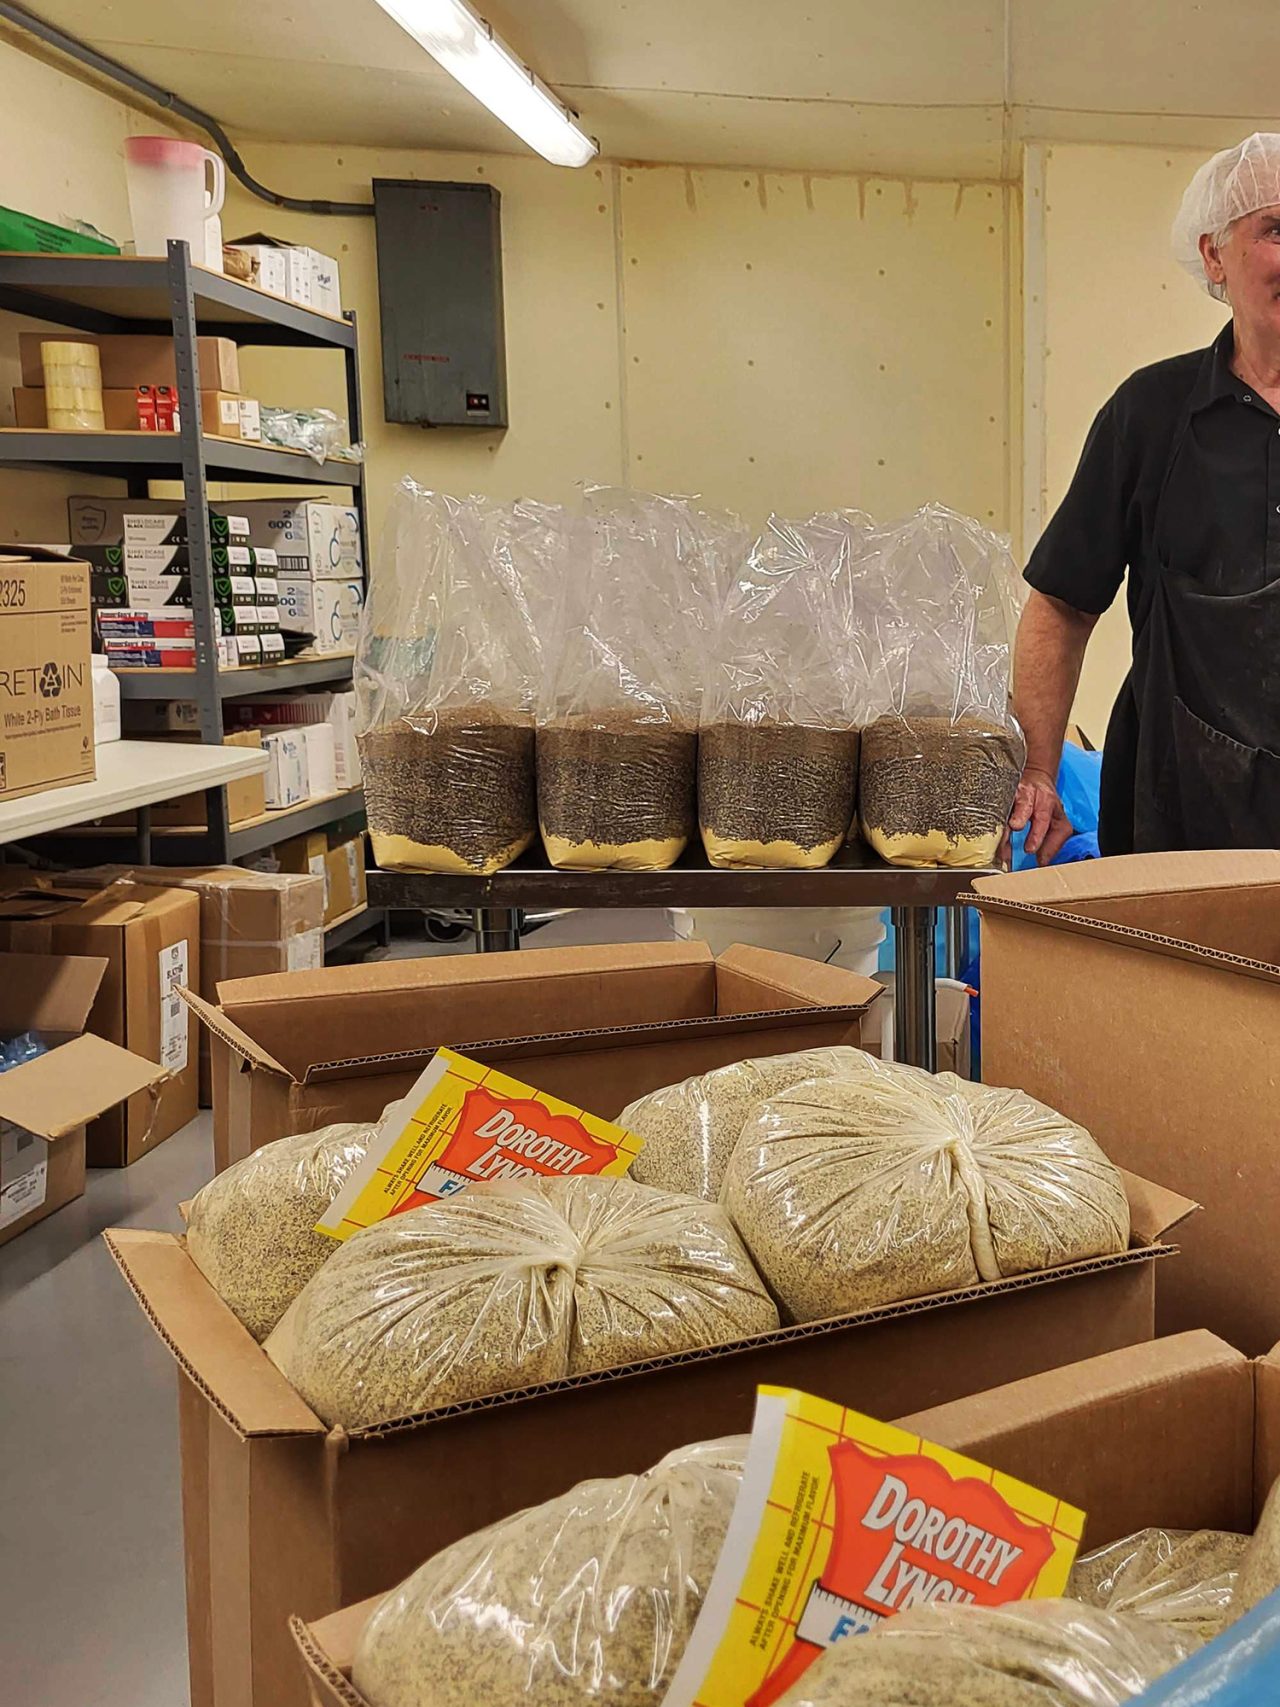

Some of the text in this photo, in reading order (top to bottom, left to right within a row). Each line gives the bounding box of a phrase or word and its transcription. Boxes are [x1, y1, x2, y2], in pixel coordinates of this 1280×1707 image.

[268, 520, 292, 528] 600
[282, 510, 292, 518] 2
[0, 579, 26, 608] 325
[0, 662, 83, 697] RETAIN
[4, 704, 81, 728] White 2-Ply Bath Tissue
[383, 1103, 447, 1194] ALWAYS SHAKE WELL AND REFRIGERATE
[389, 1180, 403, 1196] AFTER
[400, 1158, 417, 1181] OPENING
[414, 1148, 424, 1159] FOR
[421, 1124, 440, 1149] MAXIMUM
[465, 1144, 544, 1181] LYN
[473, 1108, 592, 1174] DOROTHY
[860, 1473, 1024, 1587] DOROTHY
[748, 1471, 811, 1647] ALWAYS SHAKE WELL AND REFRIGERATE
[759, 1620, 776, 1651] AFTER
[771, 1578, 791, 1618] OPENING
[785, 1557, 798, 1576] FOR
[793, 1511, 811, 1556] MAXIMUM
